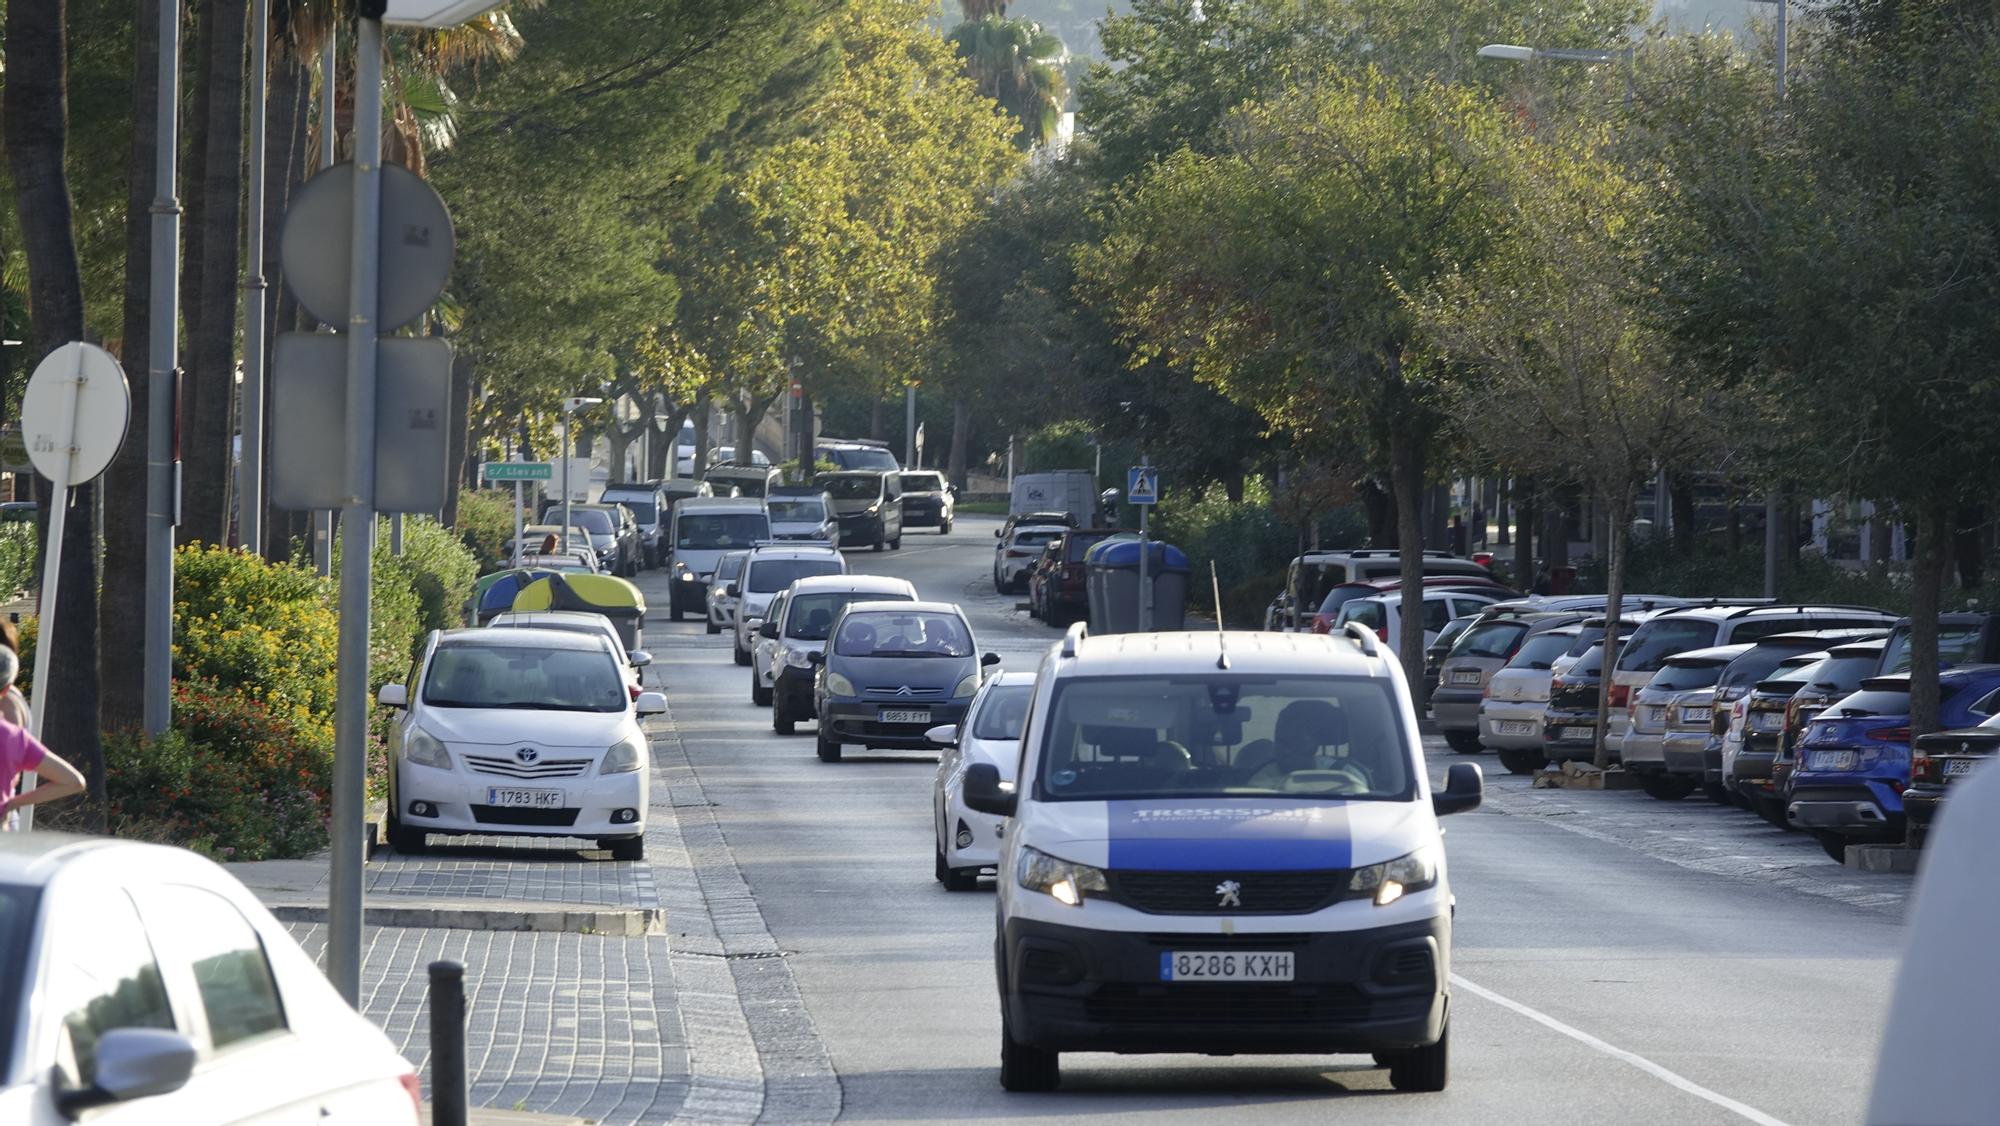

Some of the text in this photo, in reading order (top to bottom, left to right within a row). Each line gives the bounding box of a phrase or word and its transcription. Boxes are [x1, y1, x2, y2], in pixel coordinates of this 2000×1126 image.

[506, 466, 549, 477] Llevant
[501, 791, 560, 806] 1783 HKF
[1178, 955, 1289, 977] 8286 KXH
